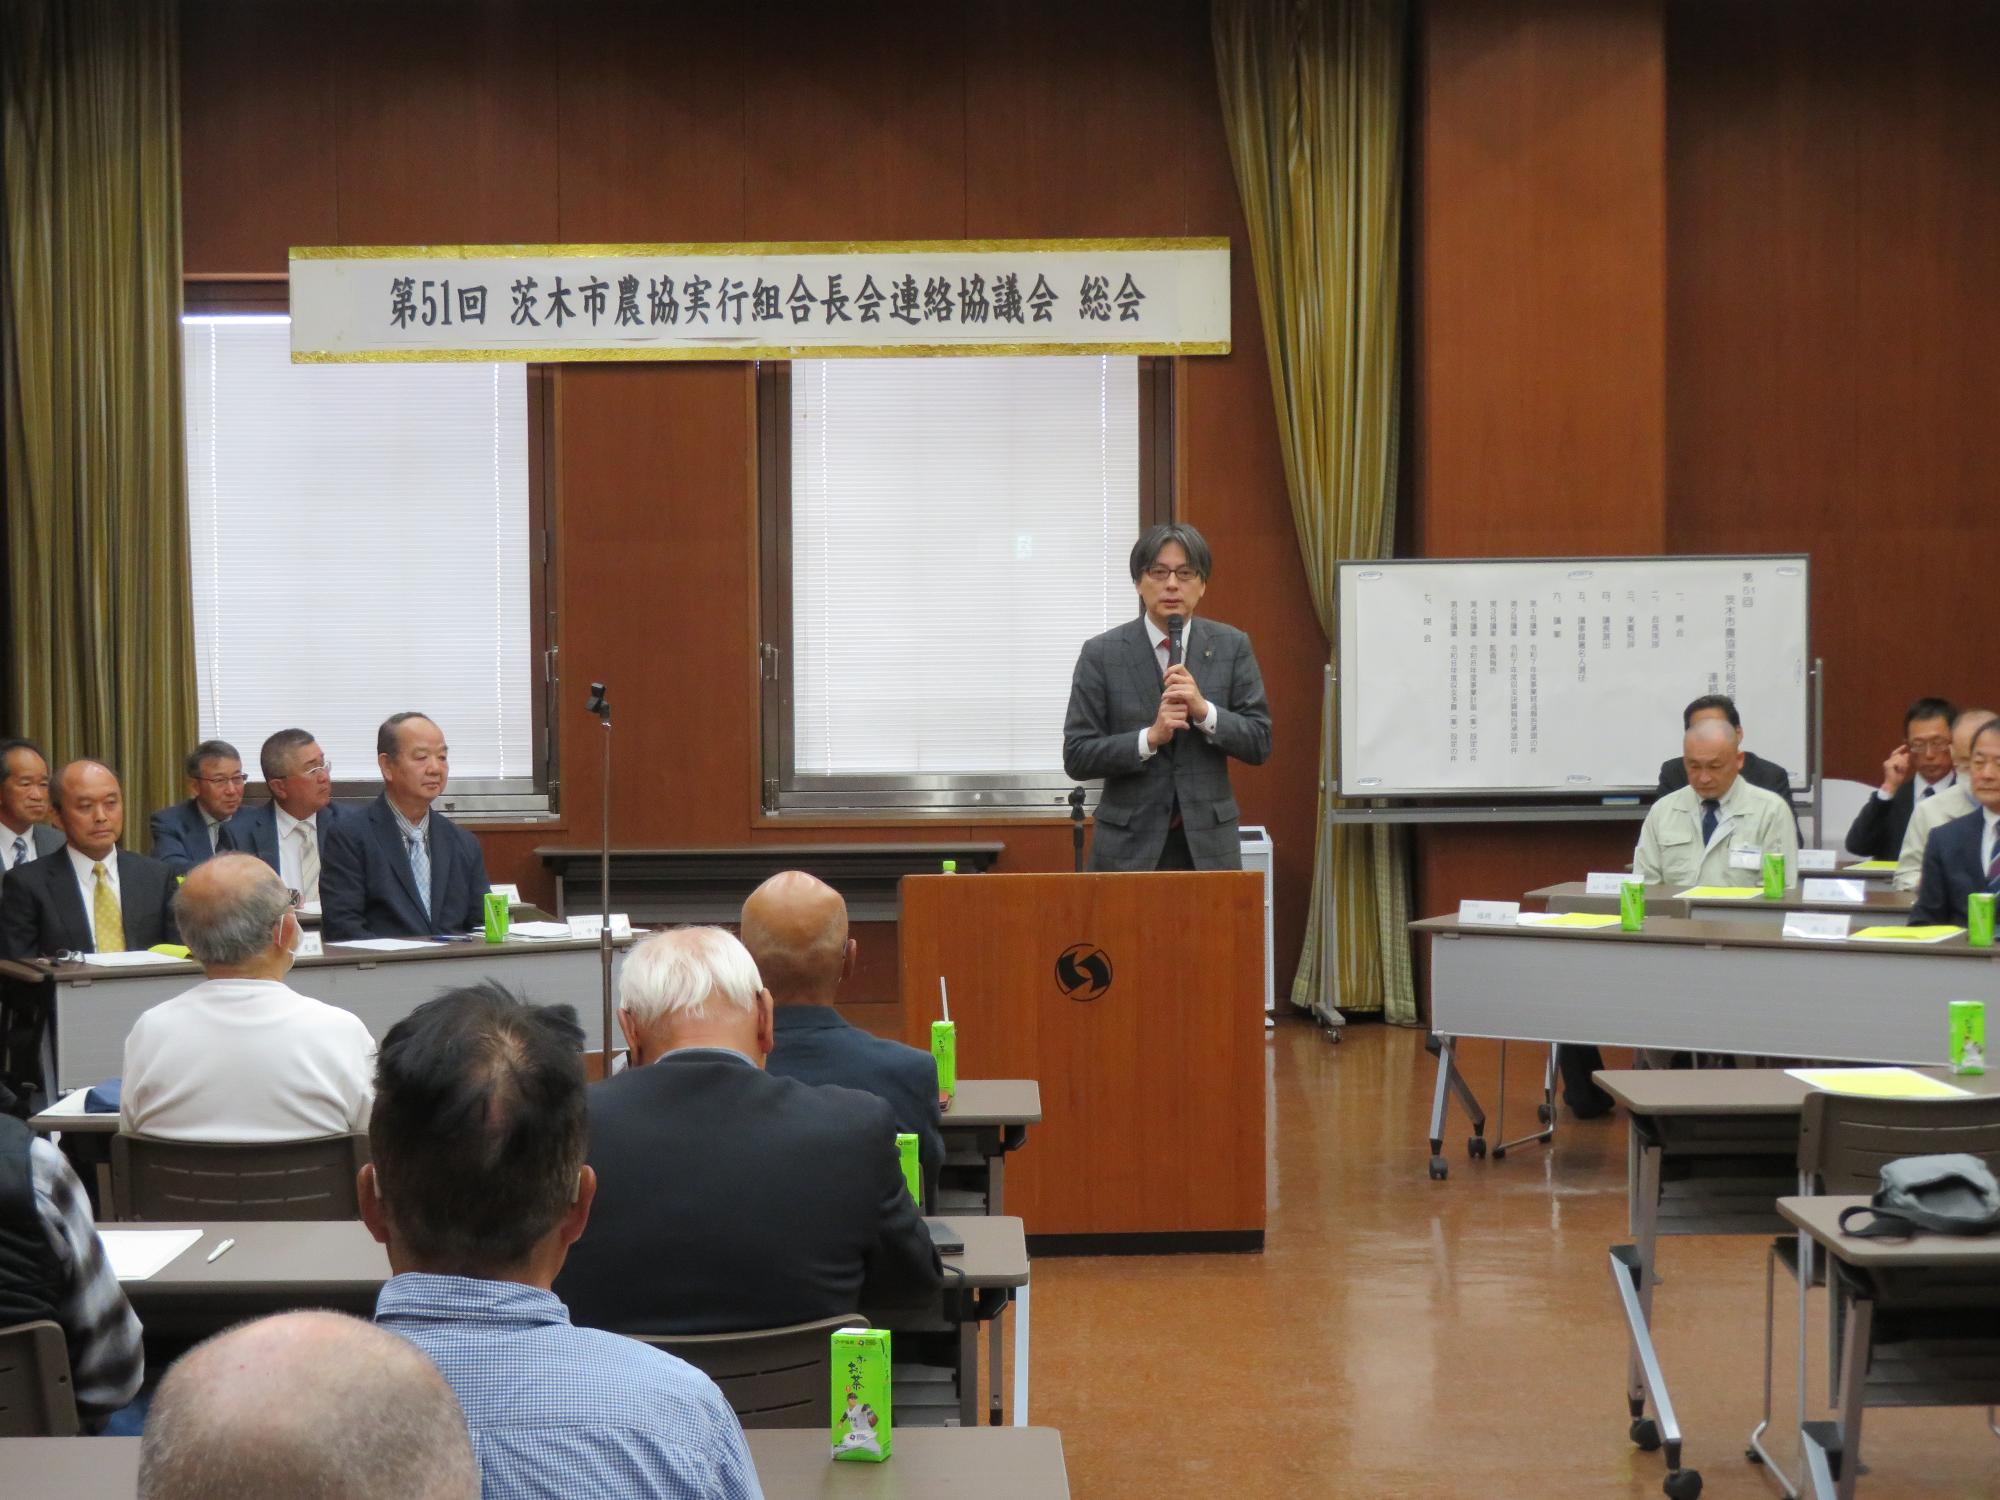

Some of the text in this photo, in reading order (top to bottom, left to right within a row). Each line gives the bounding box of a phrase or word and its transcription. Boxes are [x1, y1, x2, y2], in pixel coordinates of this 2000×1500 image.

[390, 272, 1146, 329] 第51回 茨木市農協実行組合長会連絡協議会 総会
